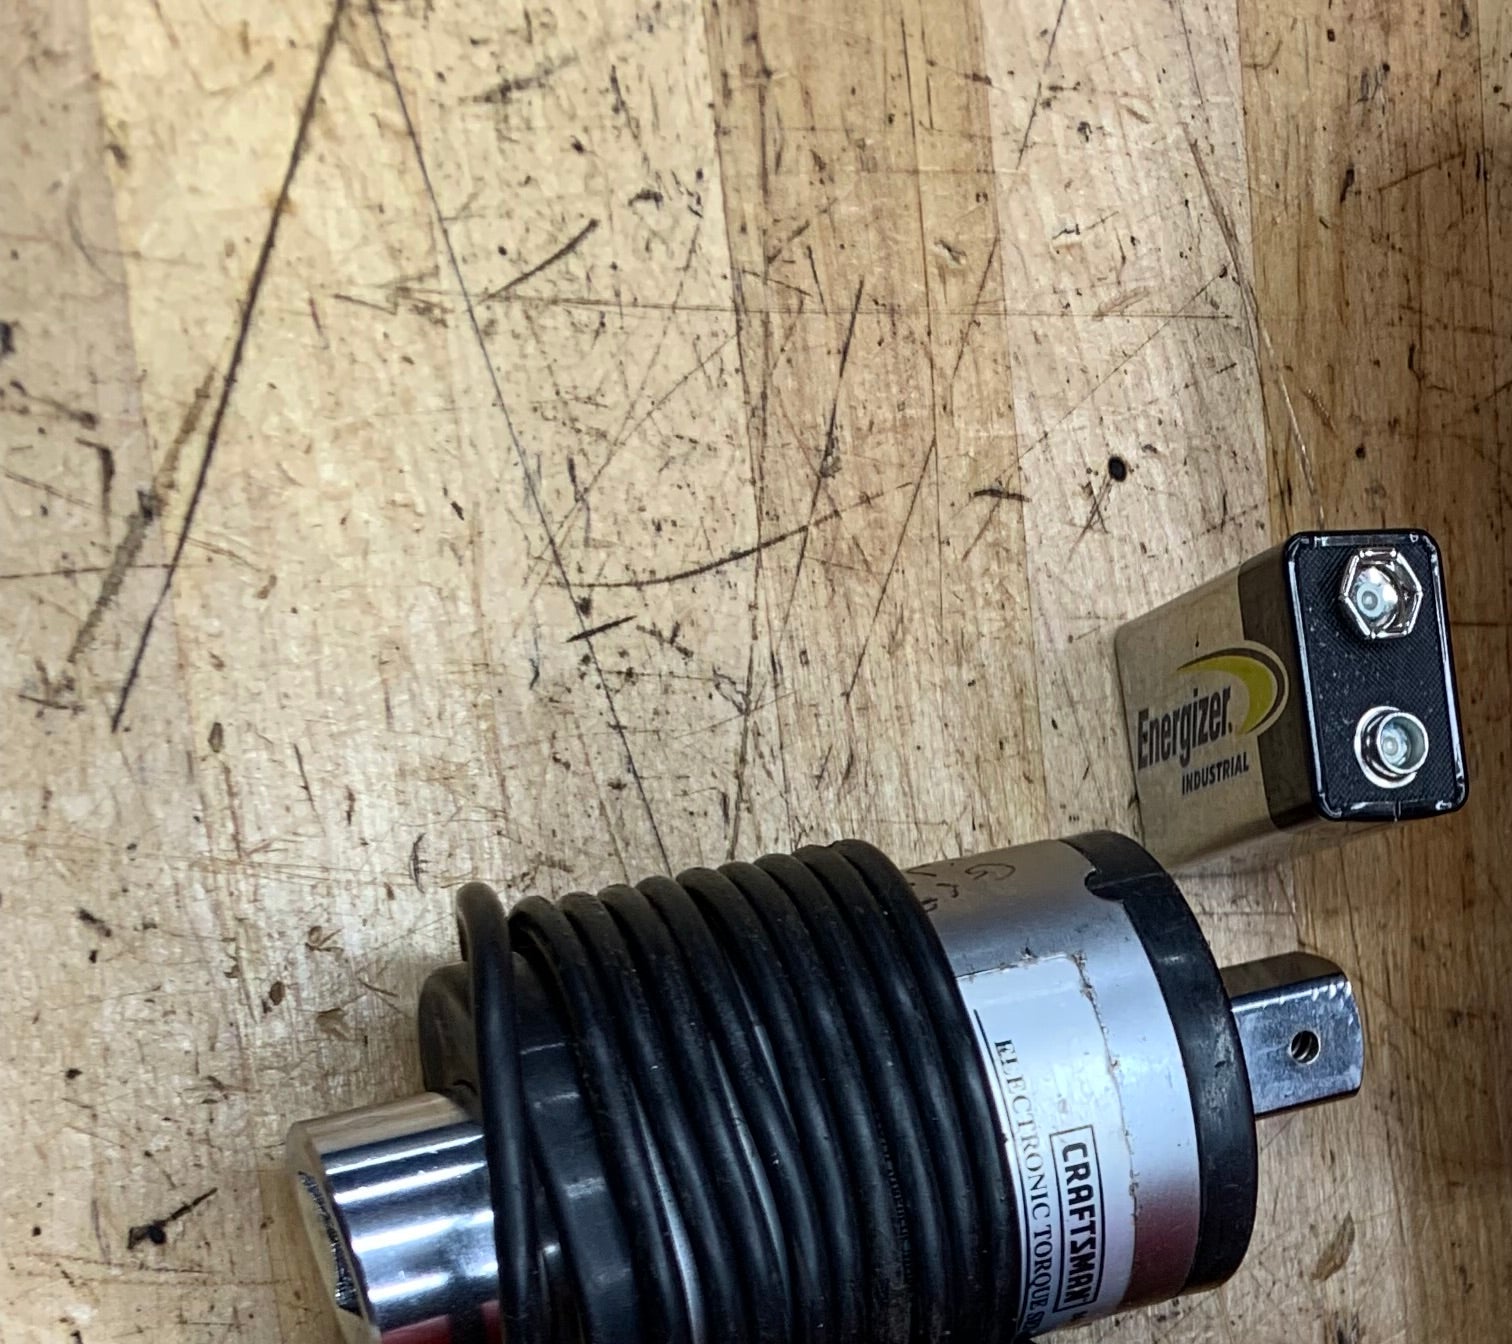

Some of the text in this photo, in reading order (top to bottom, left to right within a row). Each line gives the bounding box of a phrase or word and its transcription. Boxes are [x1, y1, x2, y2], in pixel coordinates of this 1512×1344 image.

[1182, 751, 1250, 796] INDUSTRIAL
[994, 1040, 1052, 1221] ELECTRONIC
[1028, 1224, 1053, 1311] TORQUE
[1062, 1142, 1097, 1304] CRAFTSMAN
